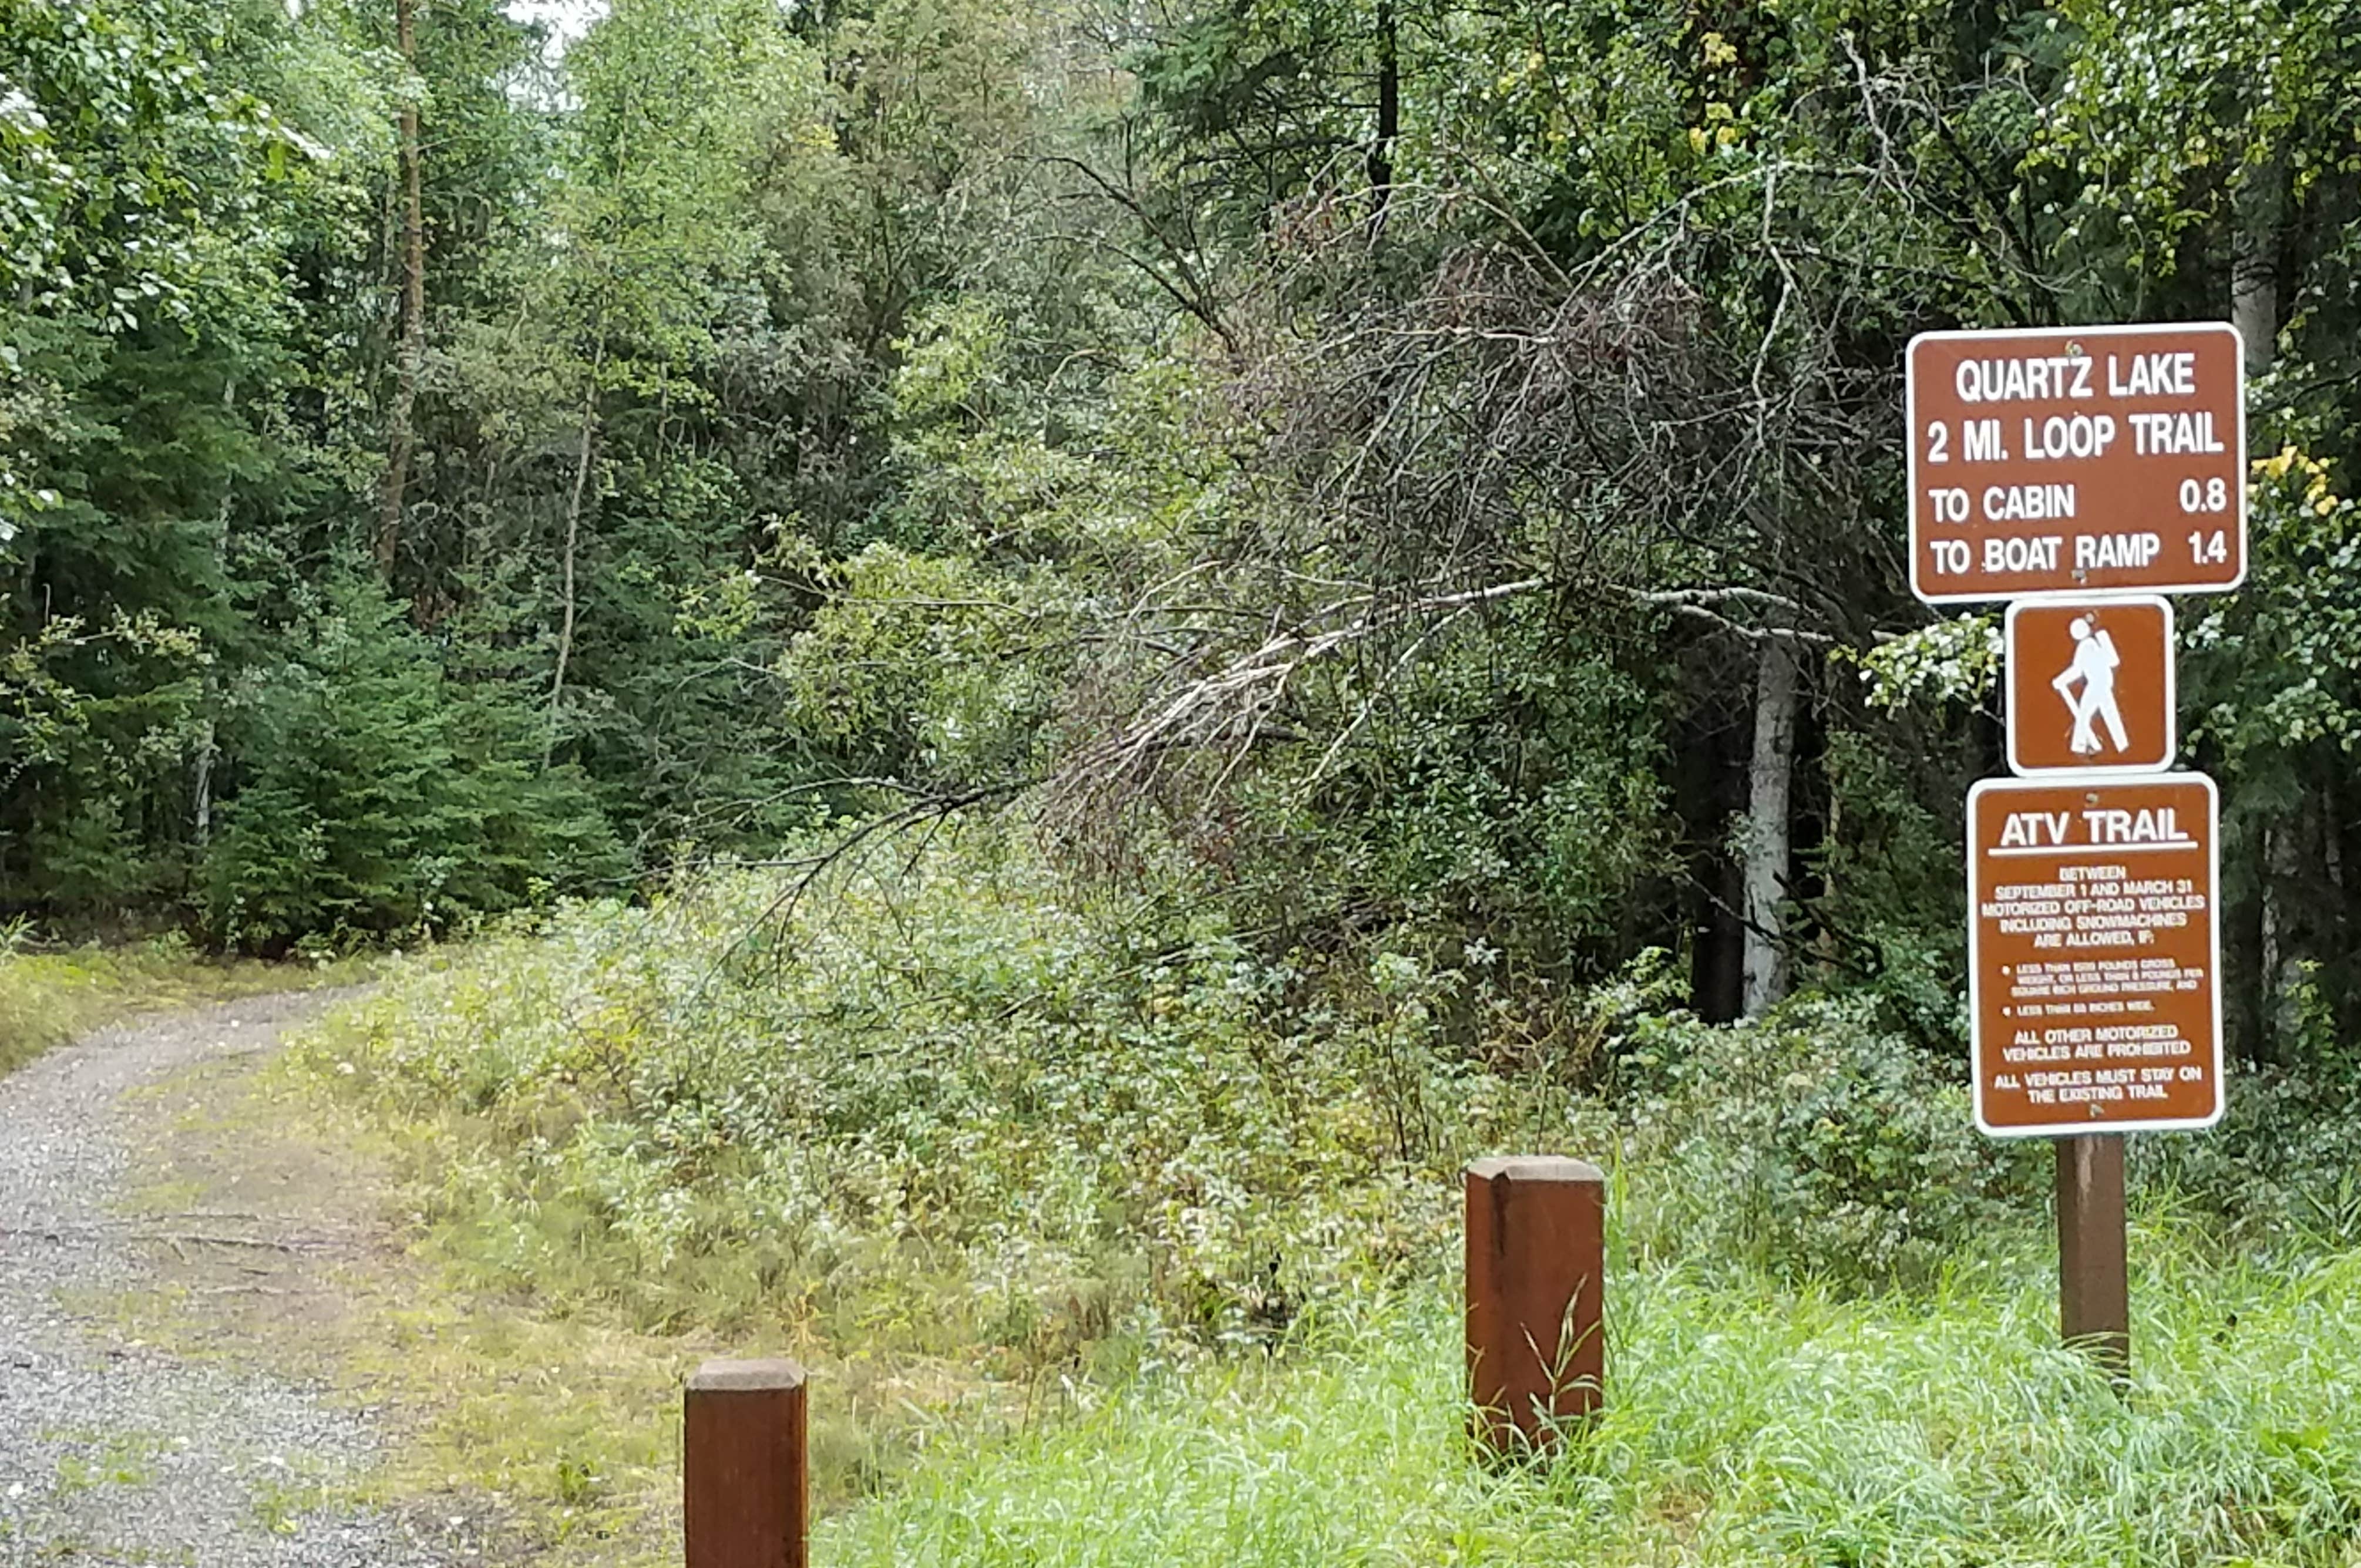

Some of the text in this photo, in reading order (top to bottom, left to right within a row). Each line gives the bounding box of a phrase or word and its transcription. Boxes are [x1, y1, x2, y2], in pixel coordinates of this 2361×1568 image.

[1956, 353, 2195, 403] QUARTZ LAKE
[1928, 412, 2224, 462] 2 MI. LOOP TRAIL
[1928, 477, 2226, 522] TO CABIN 0.8
[1930, 531, 2227, 574] TO BOAT RAMP 1.4
[2000, 807, 2188, 846] ATV TRAIL
[2060, 866, 2125, 881] BETWEEN
[1995, 879, 2192, 900] SEPTEMBER 1 AND MARCH 31
[1982, 894, 2205, 917] MOTORIZED OFF-ROAD VEHICLES
[2000, 912, 2187, 933] INCLUDING SNOWMACHINES
[2033, 934, 2062, 947] ARE
[2066, 930, 2134, 947] ALLOWED,
[2014, 1024, 2179, 1045] ALL OTHER MOTORIZED
[2002, 1040, 2192, 1062] VEHICLES ARE PROHIBITED
[1995, 1066, 2202, 1089] ALL VEHICLES MUST STAY ON
[2027, 1084, 2169, 1103] THE EXISTING TRAIL
